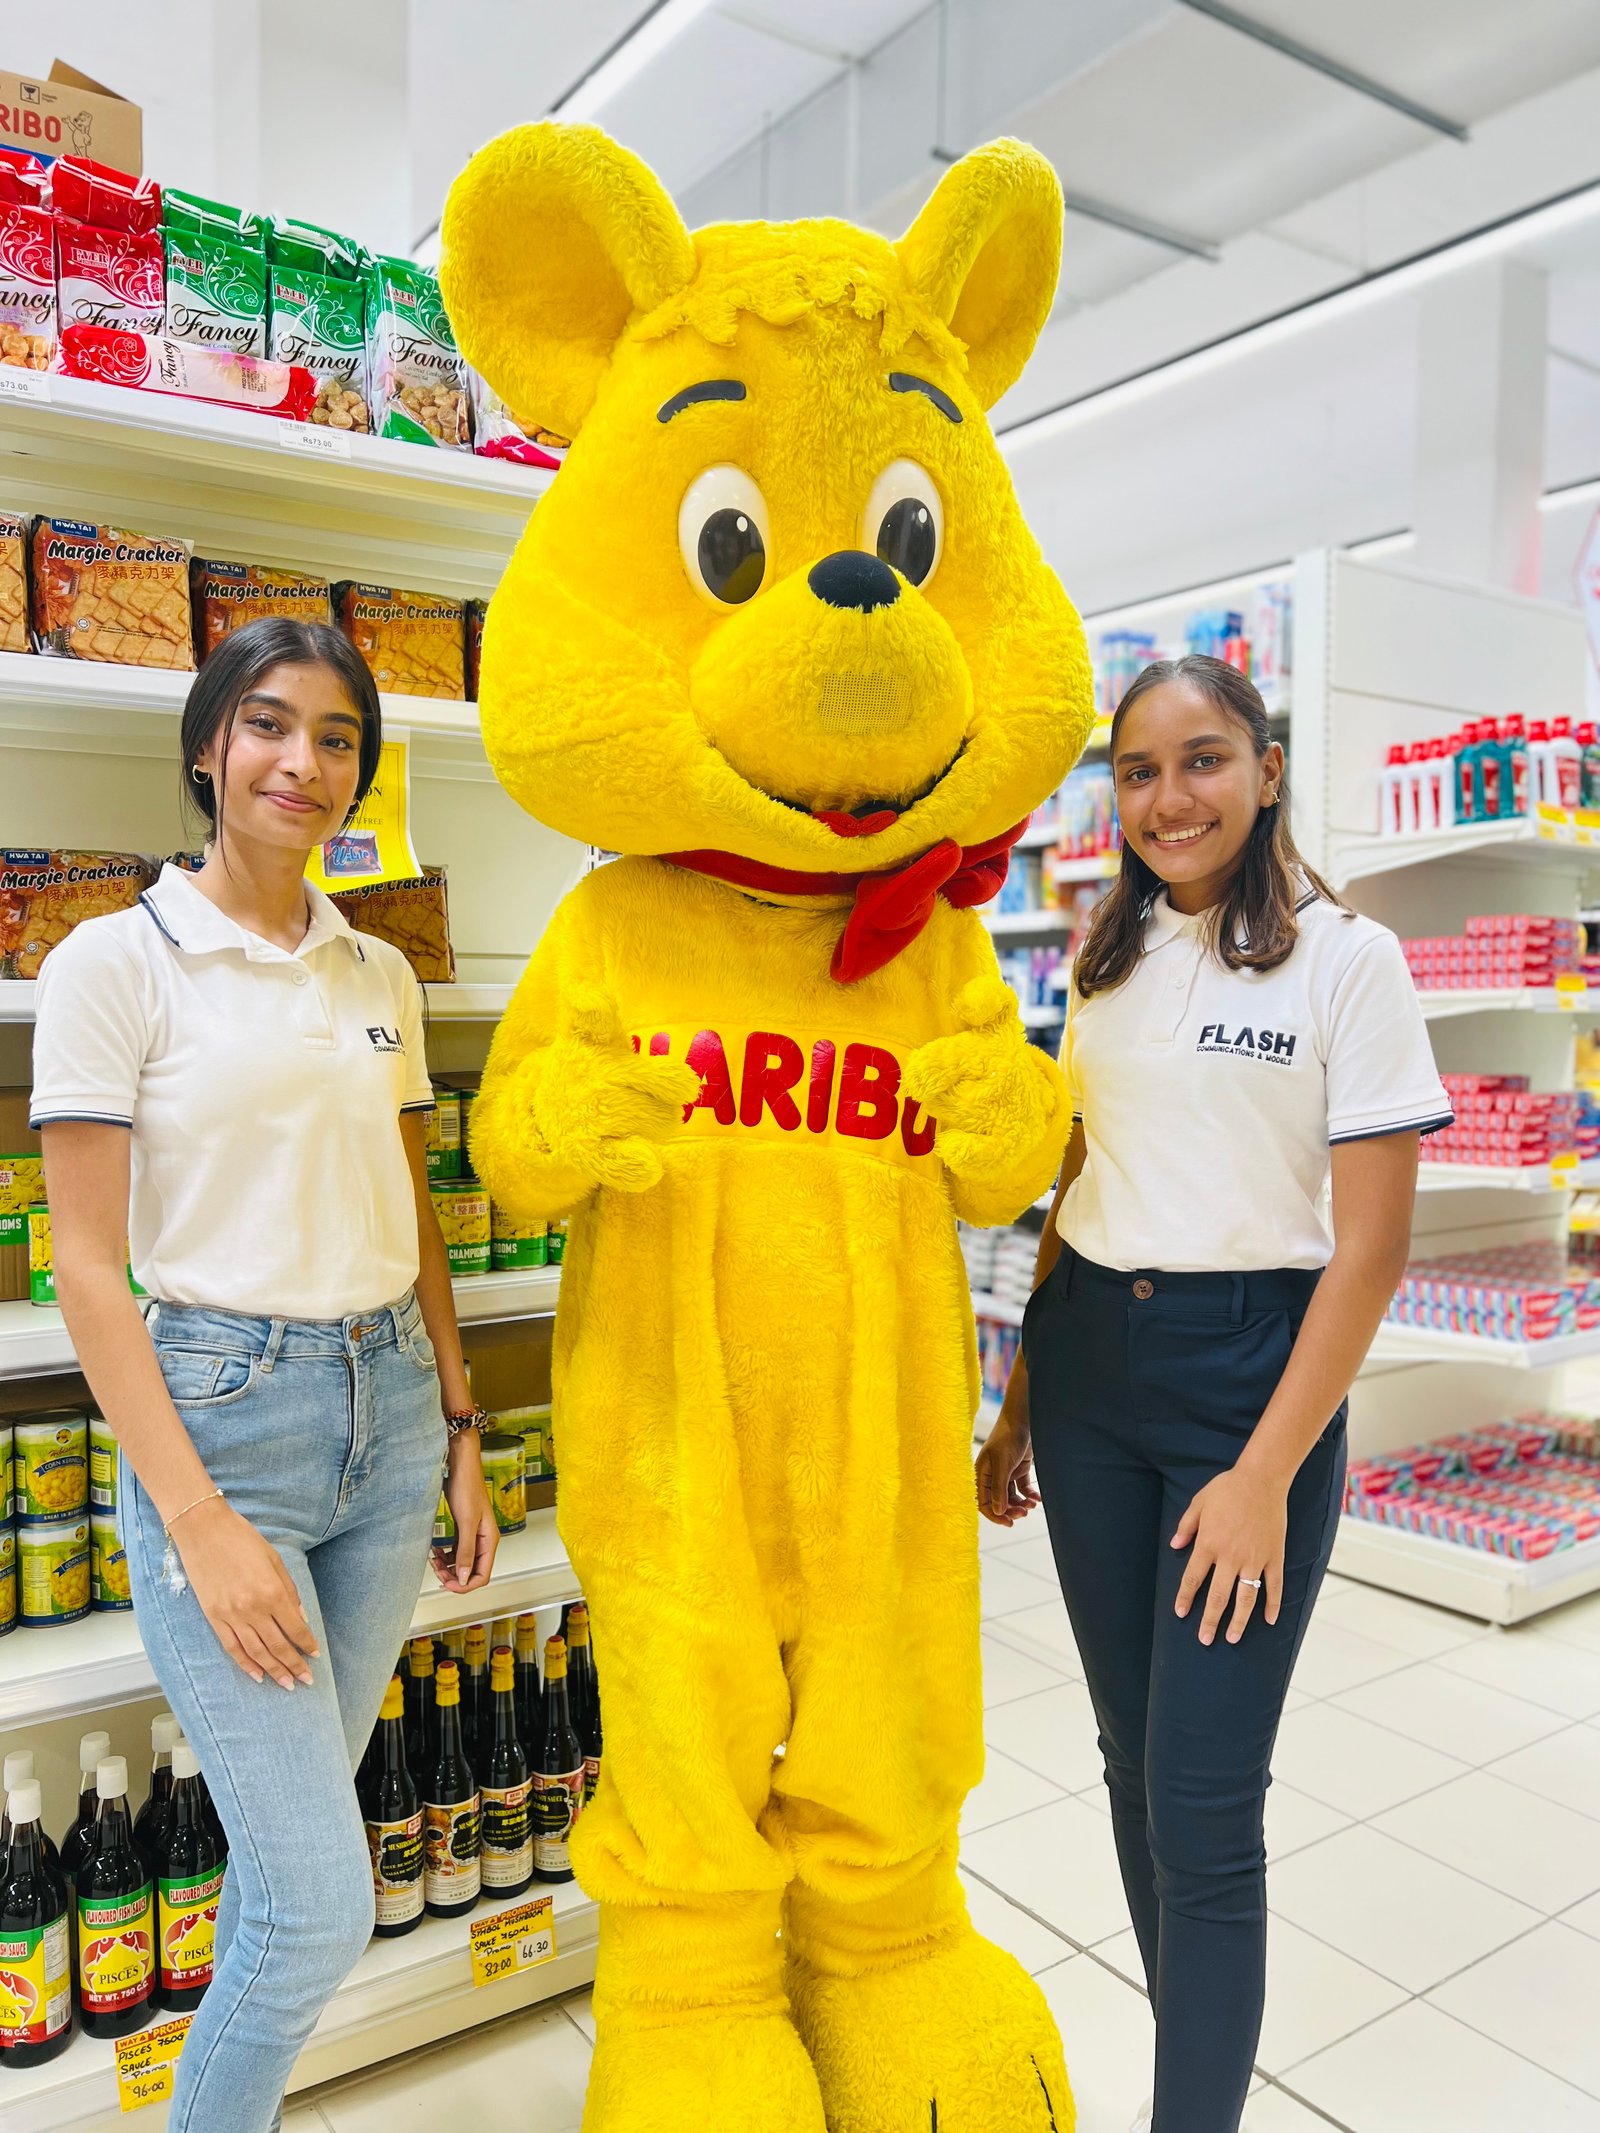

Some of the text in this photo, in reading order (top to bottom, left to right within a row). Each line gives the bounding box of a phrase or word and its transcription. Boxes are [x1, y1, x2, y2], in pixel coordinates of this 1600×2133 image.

[0, 289, 54, 324] ancy
[169, 303, 259, 354] Fancy
[158, 340, 181, 387] Fancy
[276, 332, 361, 382] Fancy
[388, 332, 467, 384] Fancy
[55, 520, 92, 532] HWA TAI
[48, 541, 111, 564] Margie
[210, 563, 228, 571] HWA
[204, 581, 328, 603] Margie Crackers
[377, 587, 389, 595] TAI
[354, 602, 404, 624] Margie
[1, 861, 141, 892] Margie Crackers
[329, 878, 387, 899] argie
[1198, 1023, 1297, 1057] FLASH
[1196, 1046, 1255, 1058] COMMUNICATIONS
[1265, 1054, 1292, 1066] MODELS
[631, 1029, 938, 1156] ARIBO
[44, 1460, 60, 1470] CORN
[168, 1887, 201, 1903] FLAVOURED
[202, 1880, 213, 1896] FISH
[86, 1896, 146, 1924] FLAVOURED FISH SAUCE
[474, 1897, 552, 1929] WAY PROMOTION
[504, 1908, 543, 1927] MUSHROOM
[8, 1942, 27, 1957] SAUCE
[522, 1940, 548, 1958] 66.30
[99, 1965, 139, 1985] PISCES
[172, 1971, 187, 1980] NET
[188, 1967, 203, 1978] WT.
[88, 1993, 103, 2002] NET
[105, 1992, 119, 2001] WT.
[120, 1986, 135, 1998] 750
[14, 2027, 30, 2037] C.C.
[120, 2016, 192, 2048] WAY PROMO
[118, 2044, 152, 2063] PISCES
[121, 2056, 152, 2075] SAUCE
[131, 2064, 167, 2079] Promo
